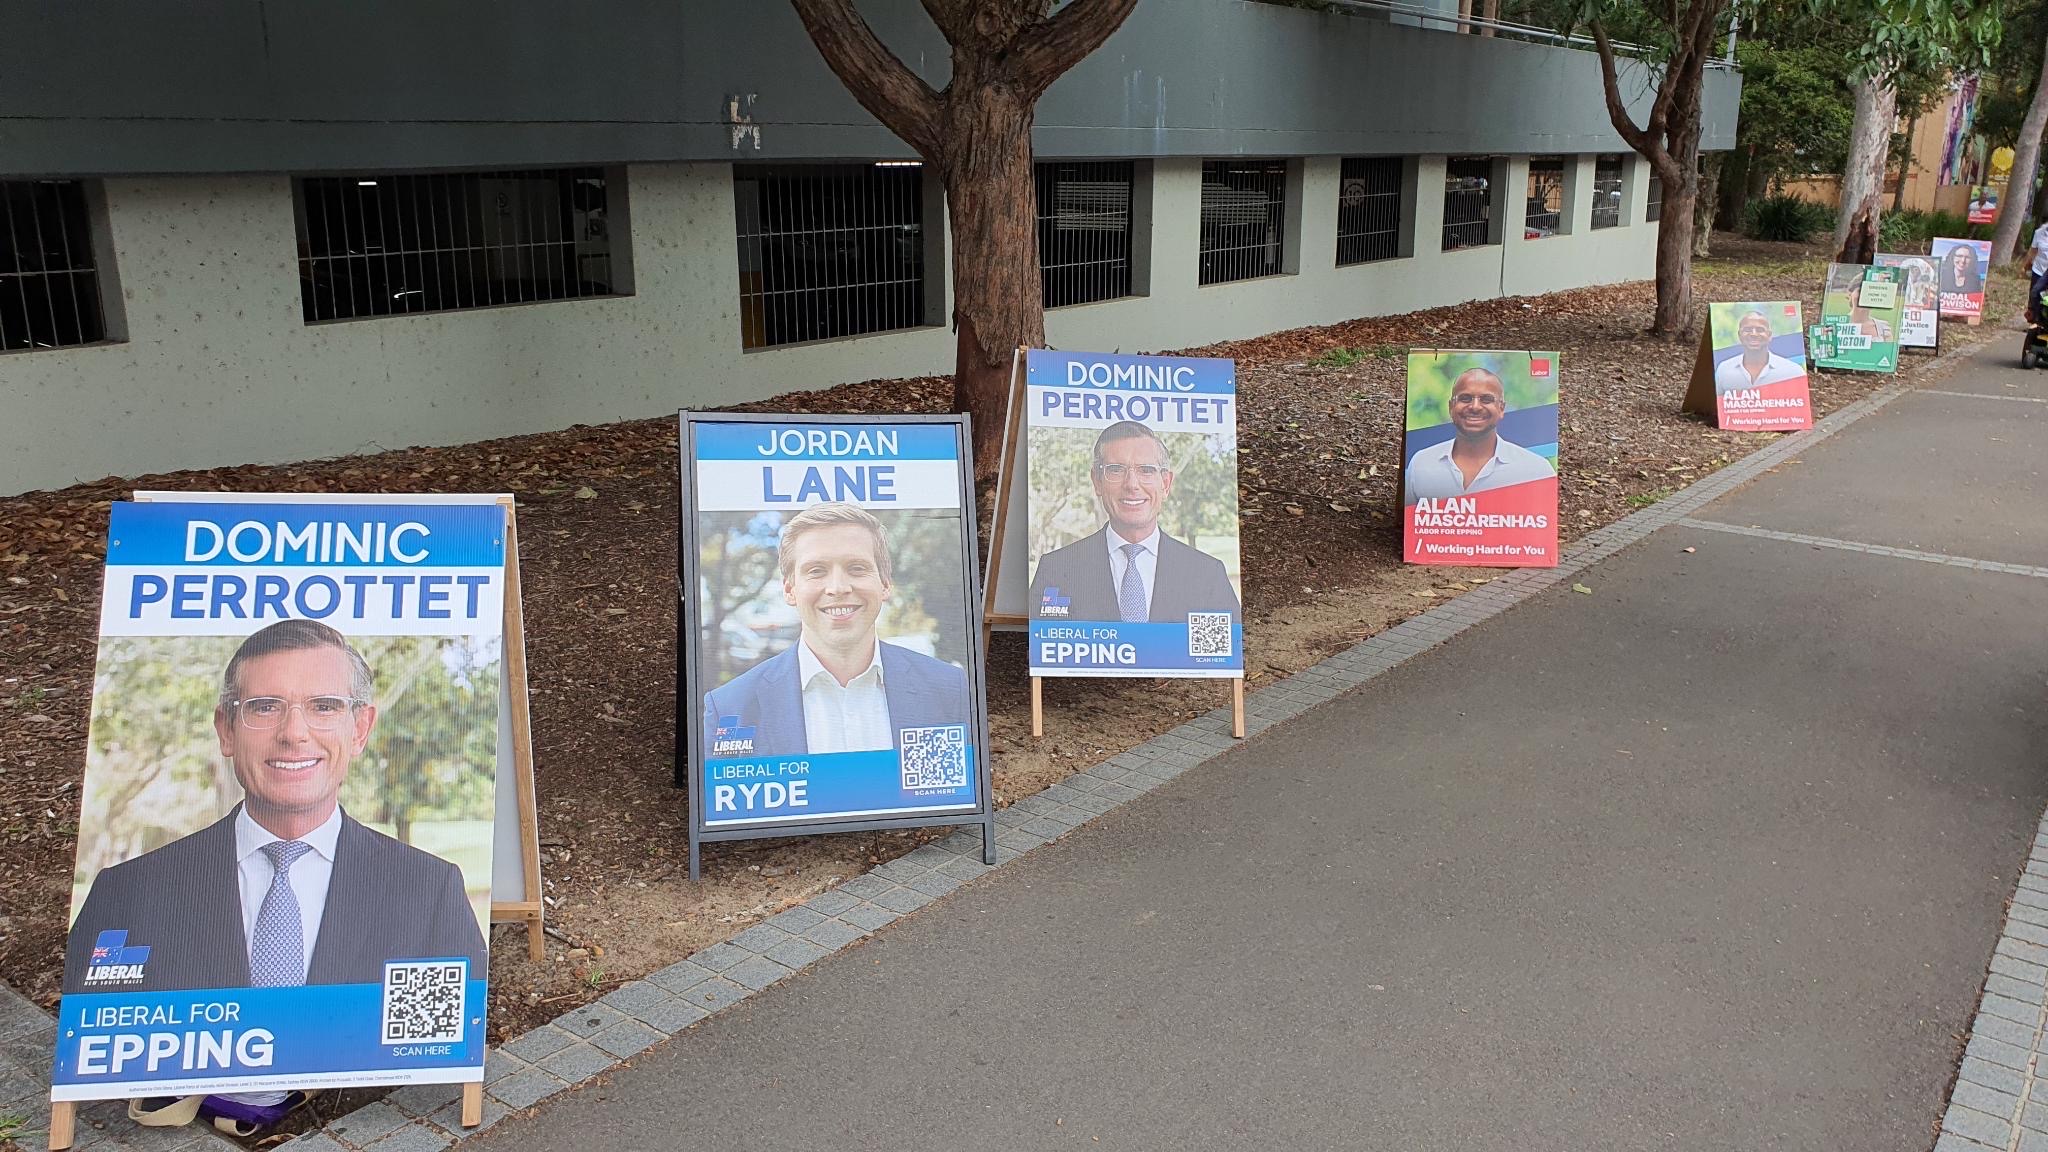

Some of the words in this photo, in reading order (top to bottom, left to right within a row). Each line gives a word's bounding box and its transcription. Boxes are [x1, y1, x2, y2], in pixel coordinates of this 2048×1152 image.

[1940, 300, 1979, 310] OWISON
[1836, 325, 1856, 335] PHIE
[1838, 336, 1866, 346] NGTON
[1067, 361, 1196, 392] DOMINIC
[1723, 389, 1760, 400] ALAN
[1042, 391, 1229, 424] PERROTTET
[1724, 398, 1804, 409] MASCARENHAS
[758, 430, 898, 456] JORDAN
[762, 466, 897, 503] LANE
[1415, 498, 1476, 514] ALAN
[1414, 514, 1547, 529] MASCARENHAS
[184, 520, 431, 564] DOMINIC
[1426, 543, 1474, 556] Working
[1476, 544, 1503, 555] Hard
[1504, 544, 1520, 555] for
[1523, 545, 1545, 555] You
[129, 574, 490, 619] PERROTTET
[1040, 606, 1069, 614] LIBERAL
[1040, 628, 1089, 640] LIBERAL
[1093, 628, 1117, 640] FOR
[1041, 642, 1136, 664] EPPING
[714, 739, 754, 751] LIBERAL
[714, 764, 775, 779] LIBERAL
[779, 762, 809, 775] FOR
[714, 780, 809, 812] RYDE
[86, 965, 144, 980] LIBERAL
[81, 1004, 182, 1028] LIBERAL
[190, 1002, 241, 1023] FOR
[77, 1028, 276, 1075] EPPING
[392, 1046, 422, 1056] SCAN
[425, 1045, 452, 1055] HERE
